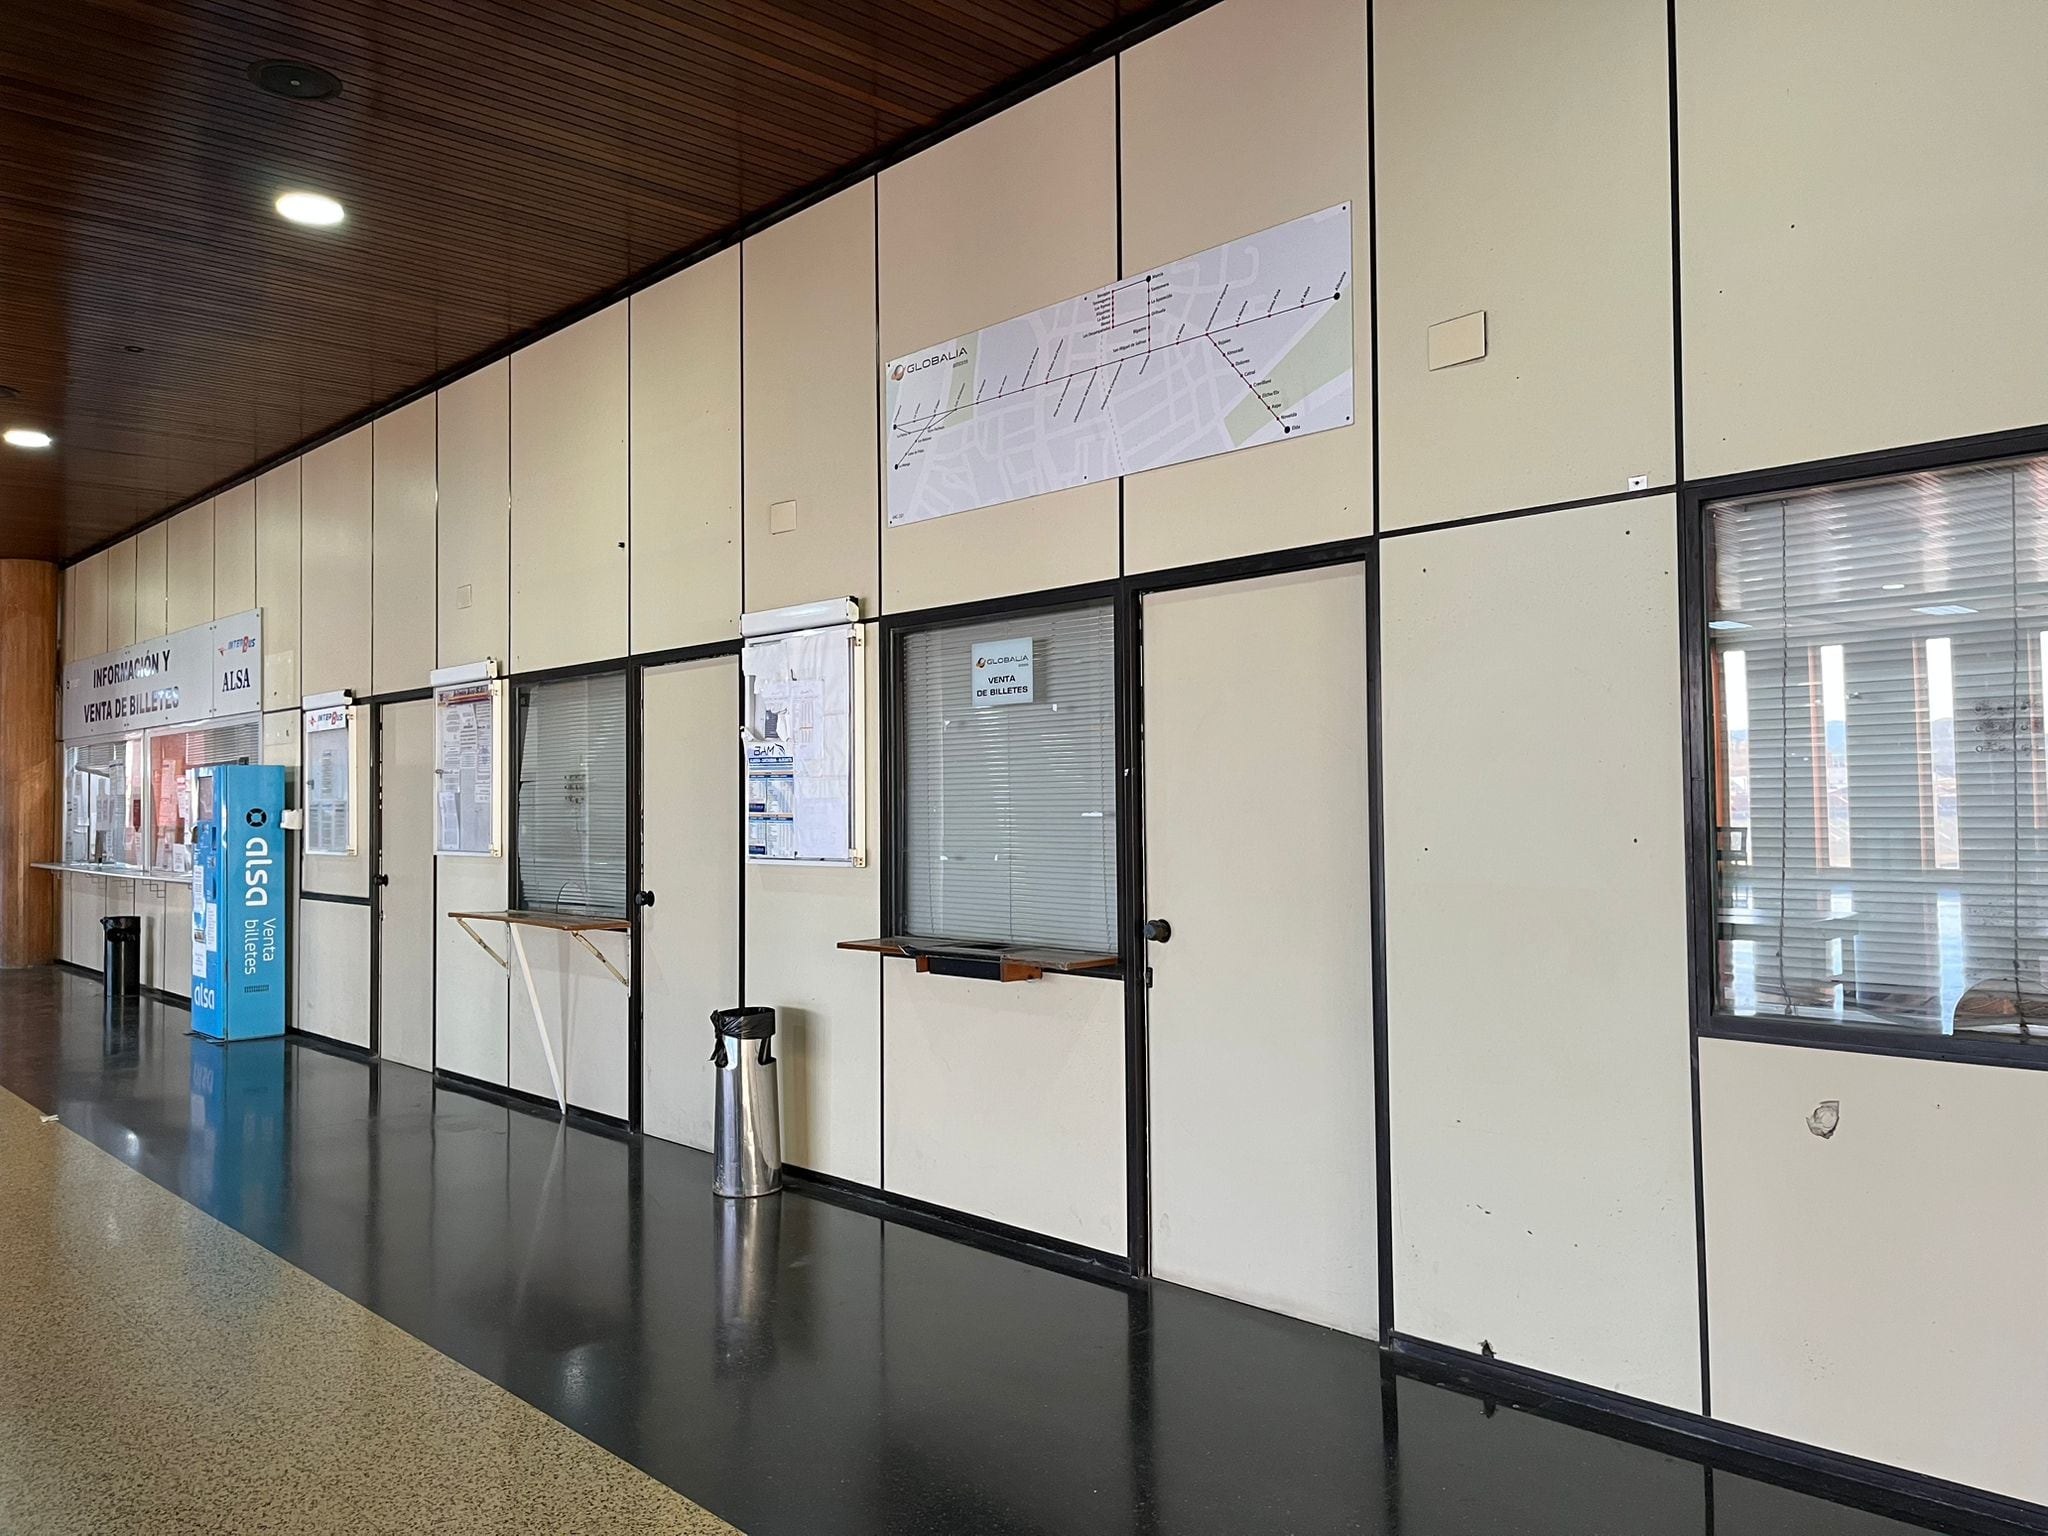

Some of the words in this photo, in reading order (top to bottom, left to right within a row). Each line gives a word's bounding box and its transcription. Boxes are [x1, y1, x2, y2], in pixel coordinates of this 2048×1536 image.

[907, 347, 968, 373] GLOBALIA
[227, 636, 256, 653] INTERBUS
[93, 650, 160, 689] INFORMACIÓN
[163, 649, 171, 672] Y
[986, 655, 1029, 665] GLOBALIA
[222, 668, 251, 692] ALSA
[988, 675, 1016, 684] VENTA
[990, 685, 1028, 696] BILLETES
[84, 703, 113, 724] VENTA
[115, 699, 128, 718] DE
[129, 686, 180, 715] BILLETES
[245, 837, 273, 906] alsa
[244, 919, 261, 975] billetes
[263, 917, 277, 962] Venta
[193, 982, 215, 1010] alsa
